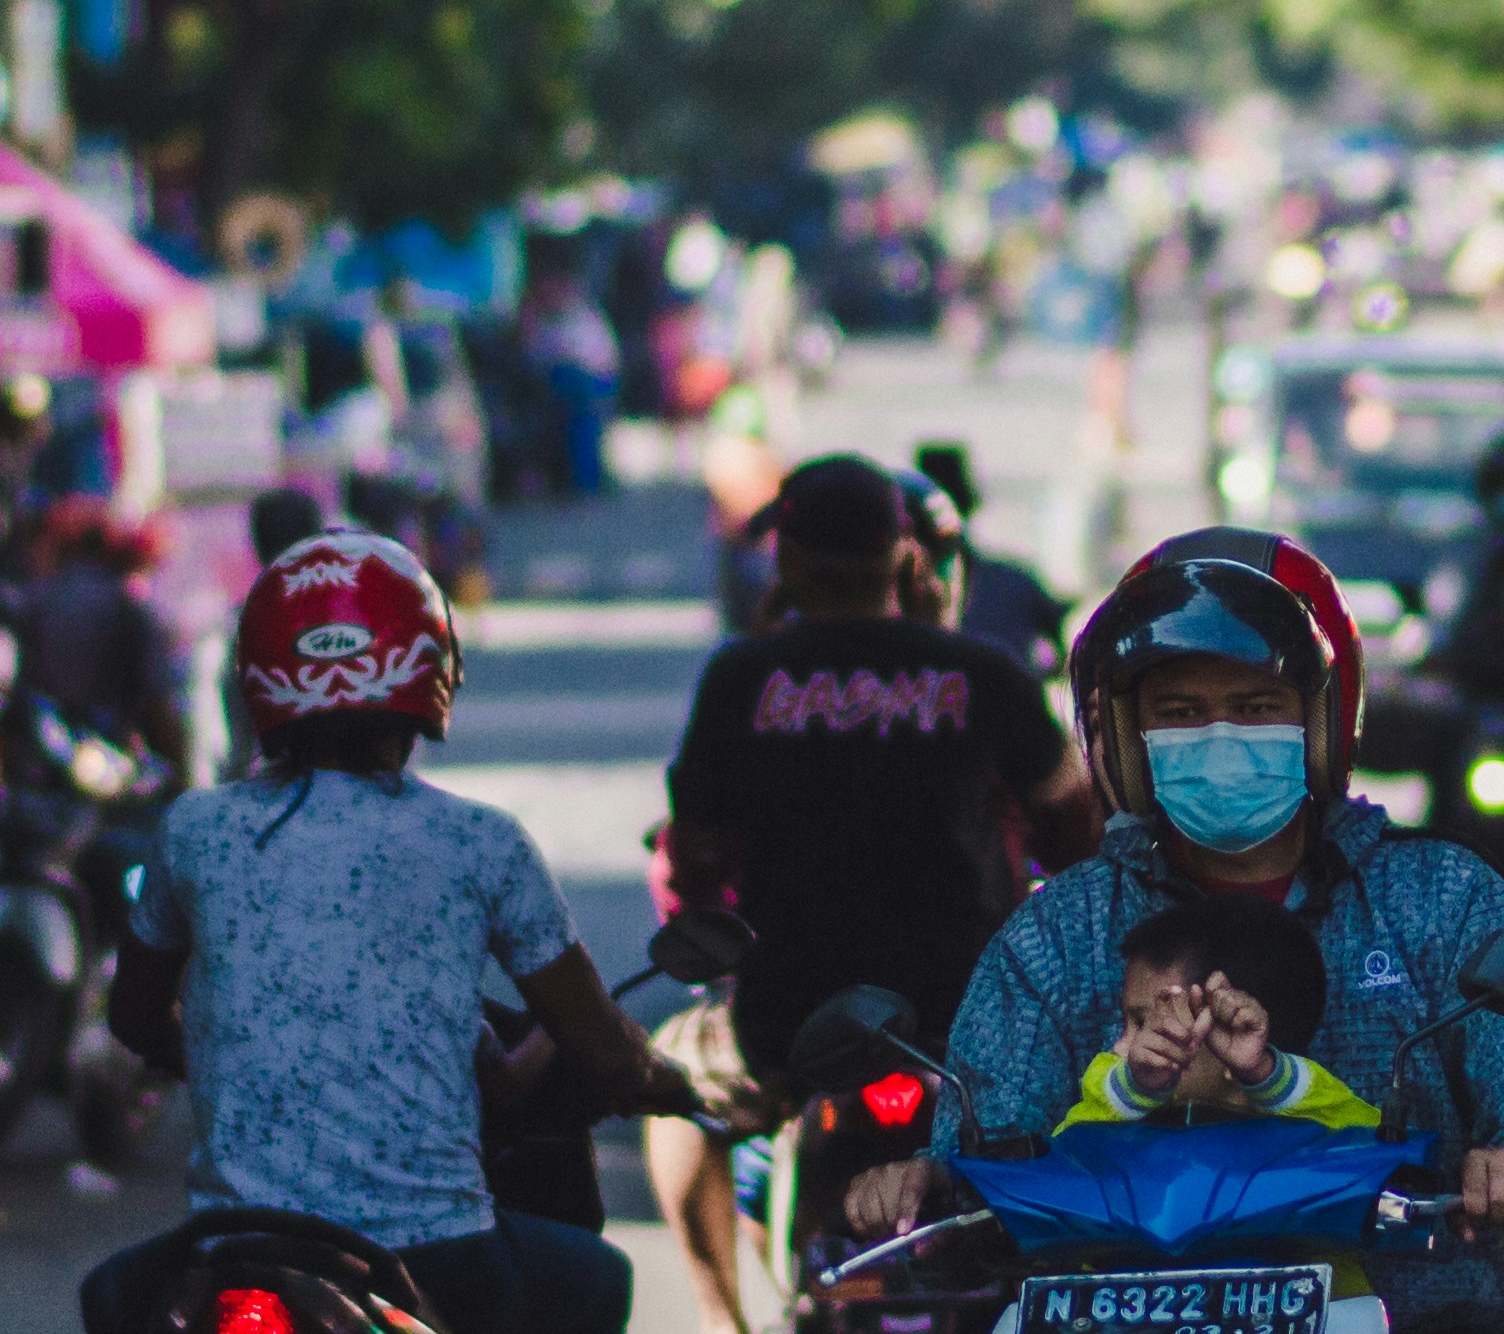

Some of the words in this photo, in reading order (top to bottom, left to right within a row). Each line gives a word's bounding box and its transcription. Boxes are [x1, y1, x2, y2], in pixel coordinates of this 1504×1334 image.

[1358, 973, 1402, 989] VOLCOM
[1044, 1288, 1072, 1322] N
[1091, 1283, 1206, 1322] 6322
